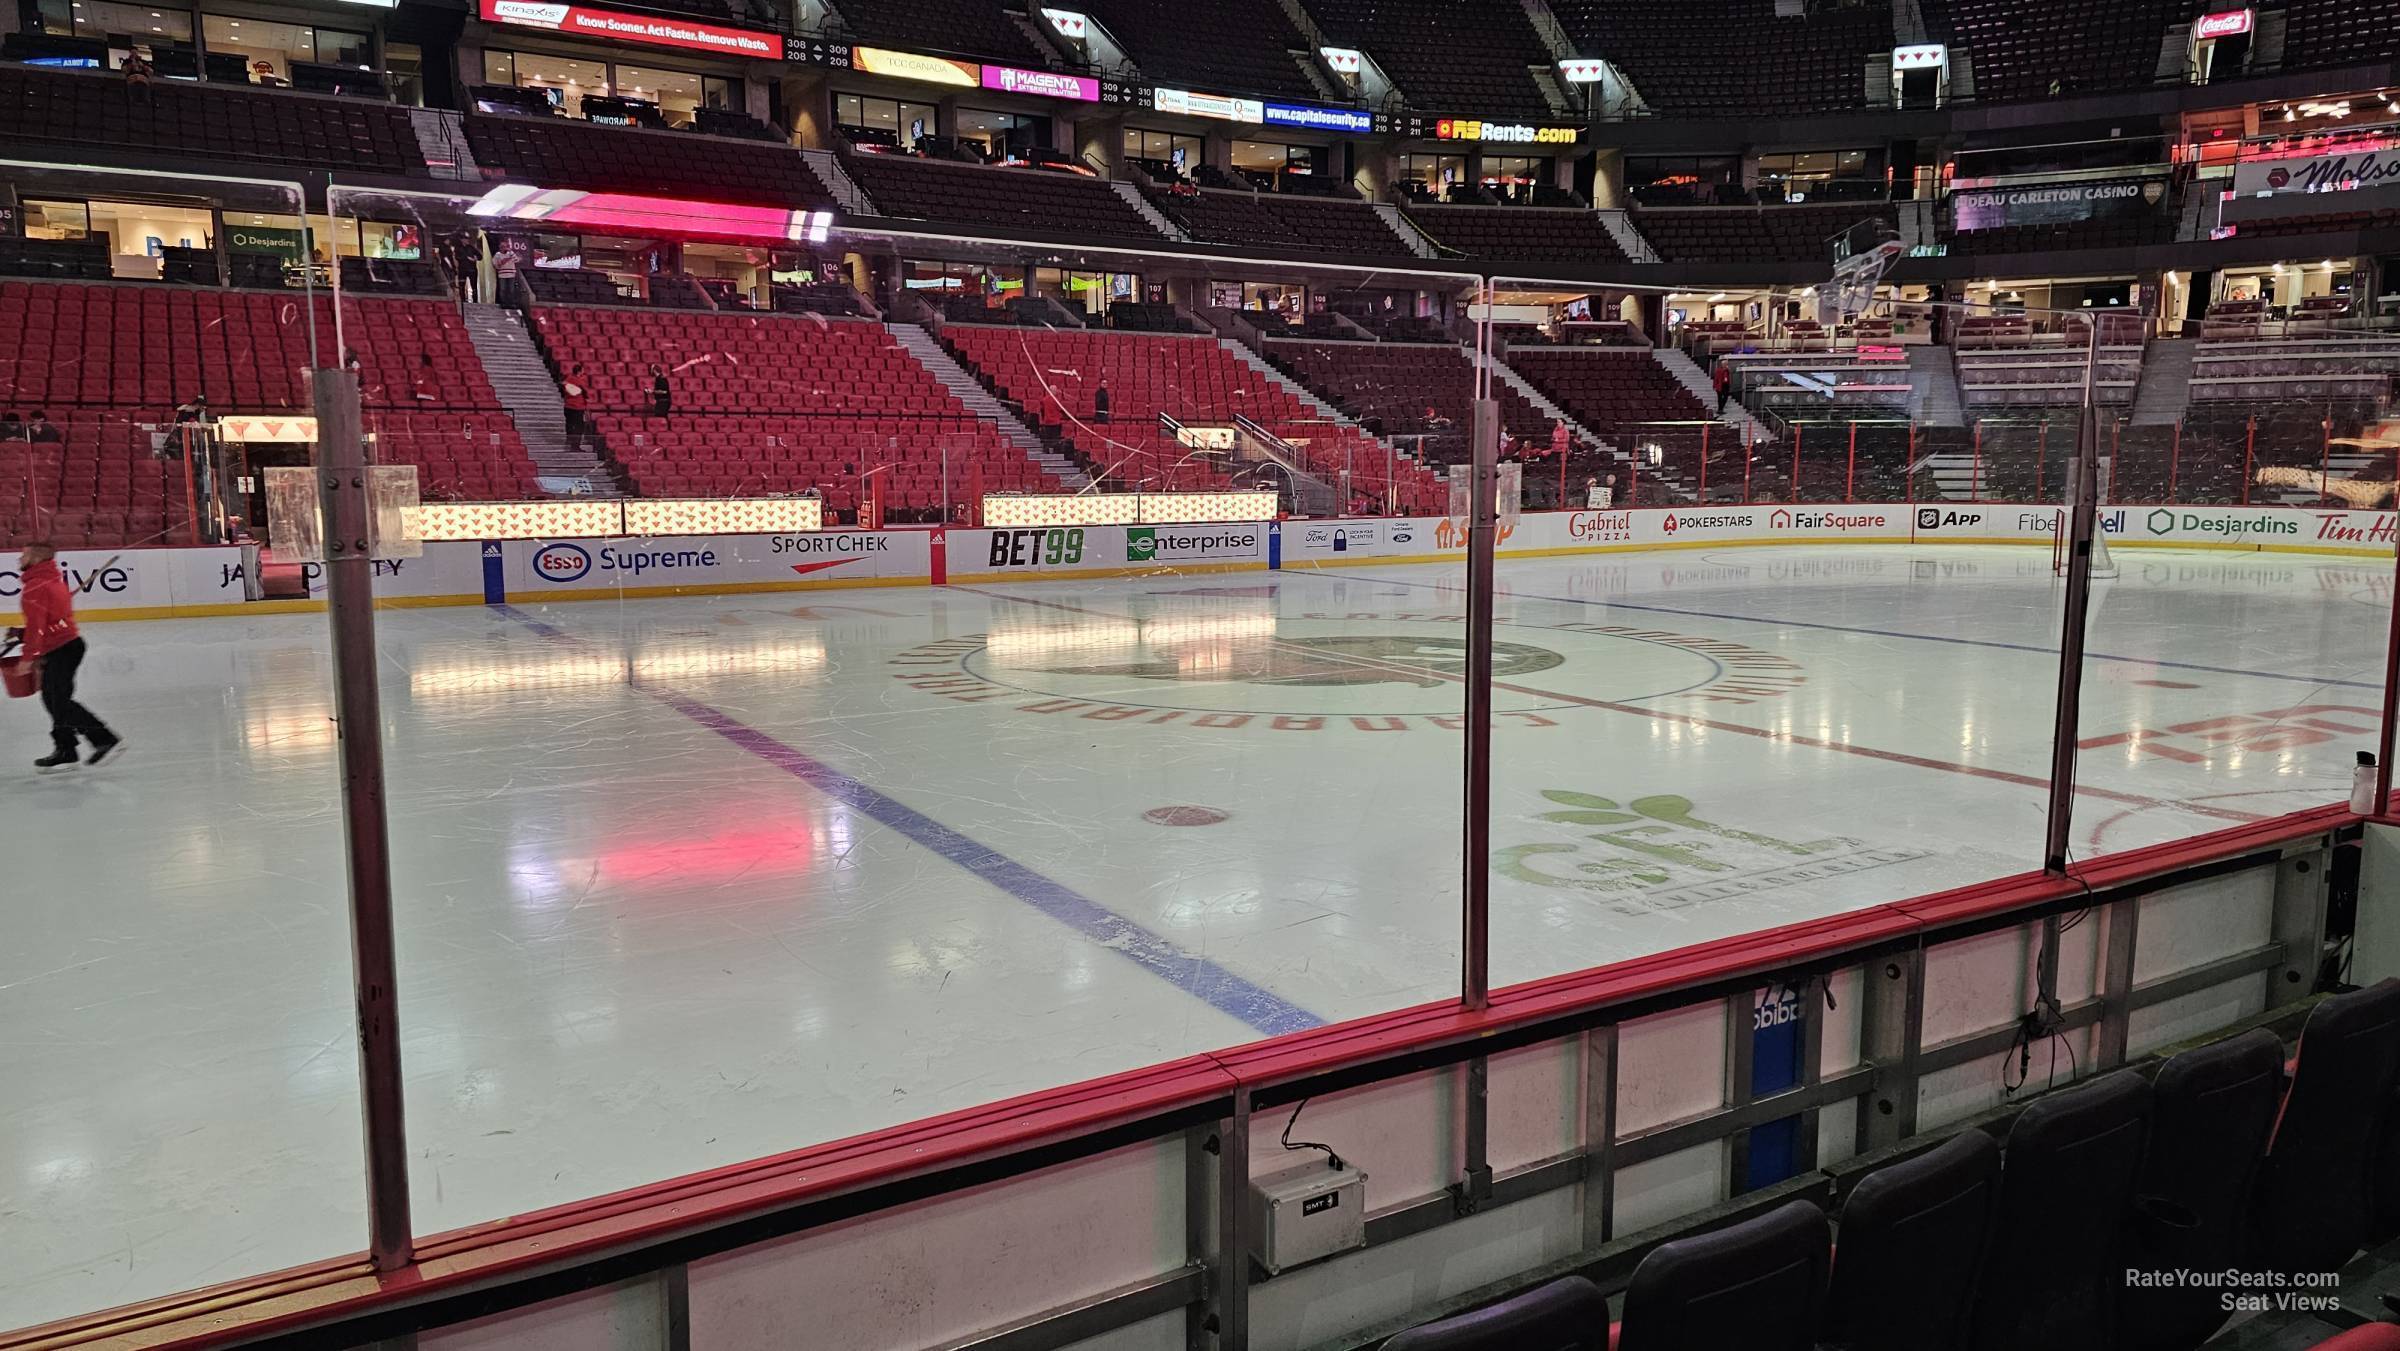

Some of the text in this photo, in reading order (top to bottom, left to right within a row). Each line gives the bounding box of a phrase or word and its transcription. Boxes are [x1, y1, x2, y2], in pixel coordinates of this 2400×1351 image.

[576, 14, 769, 51] Know Sooner. Act Faster. Remove Waste.
[786, 38, 848, 55] 308 309
[787, 50, 848, 67] 208 209
[908, 61, 947, 74] CANADA
[1016, 71, 1080, 90] MAGENTA
[1102, 83, 1151, 96] 309 310
[1102, 94, 1151, 107] 209 210
[1266, 107, 1371, 128] www.capitalsecurity.ca
[1375, 115, 1421, 126] 310 311
[1375, 125, 1421, 136] 210 211
[2009, 187, 2081, 204] CARLETON
[249, 236, 296, 248] Desjardins
[822, 263, 838, 271] 106
[1570, 512, 1631, 538] Gabriel
[1679, 516, 1753, 528] POKERSTARS
[1795, 513, 1886, 530] FairSquare
[2101, 511, 2126, 533] ell
[2182, 514, 2298, 534] Desjardins
[2316, 514, 2364, 542] Tim
[771, 535, 888, 553] SPORTCHEK
[1129, 531, 1256, 553] enterprise
[1305, 530, 1327, 542] Ford
[1588, 533, 1631, 541] PIZZA
[989, 529, 1084, 567] BET99
[542, 552, 584, 570] Esso
[600, 547, 715, 575] Supreme
[1305, 1200, 1325, 1211] SMT
